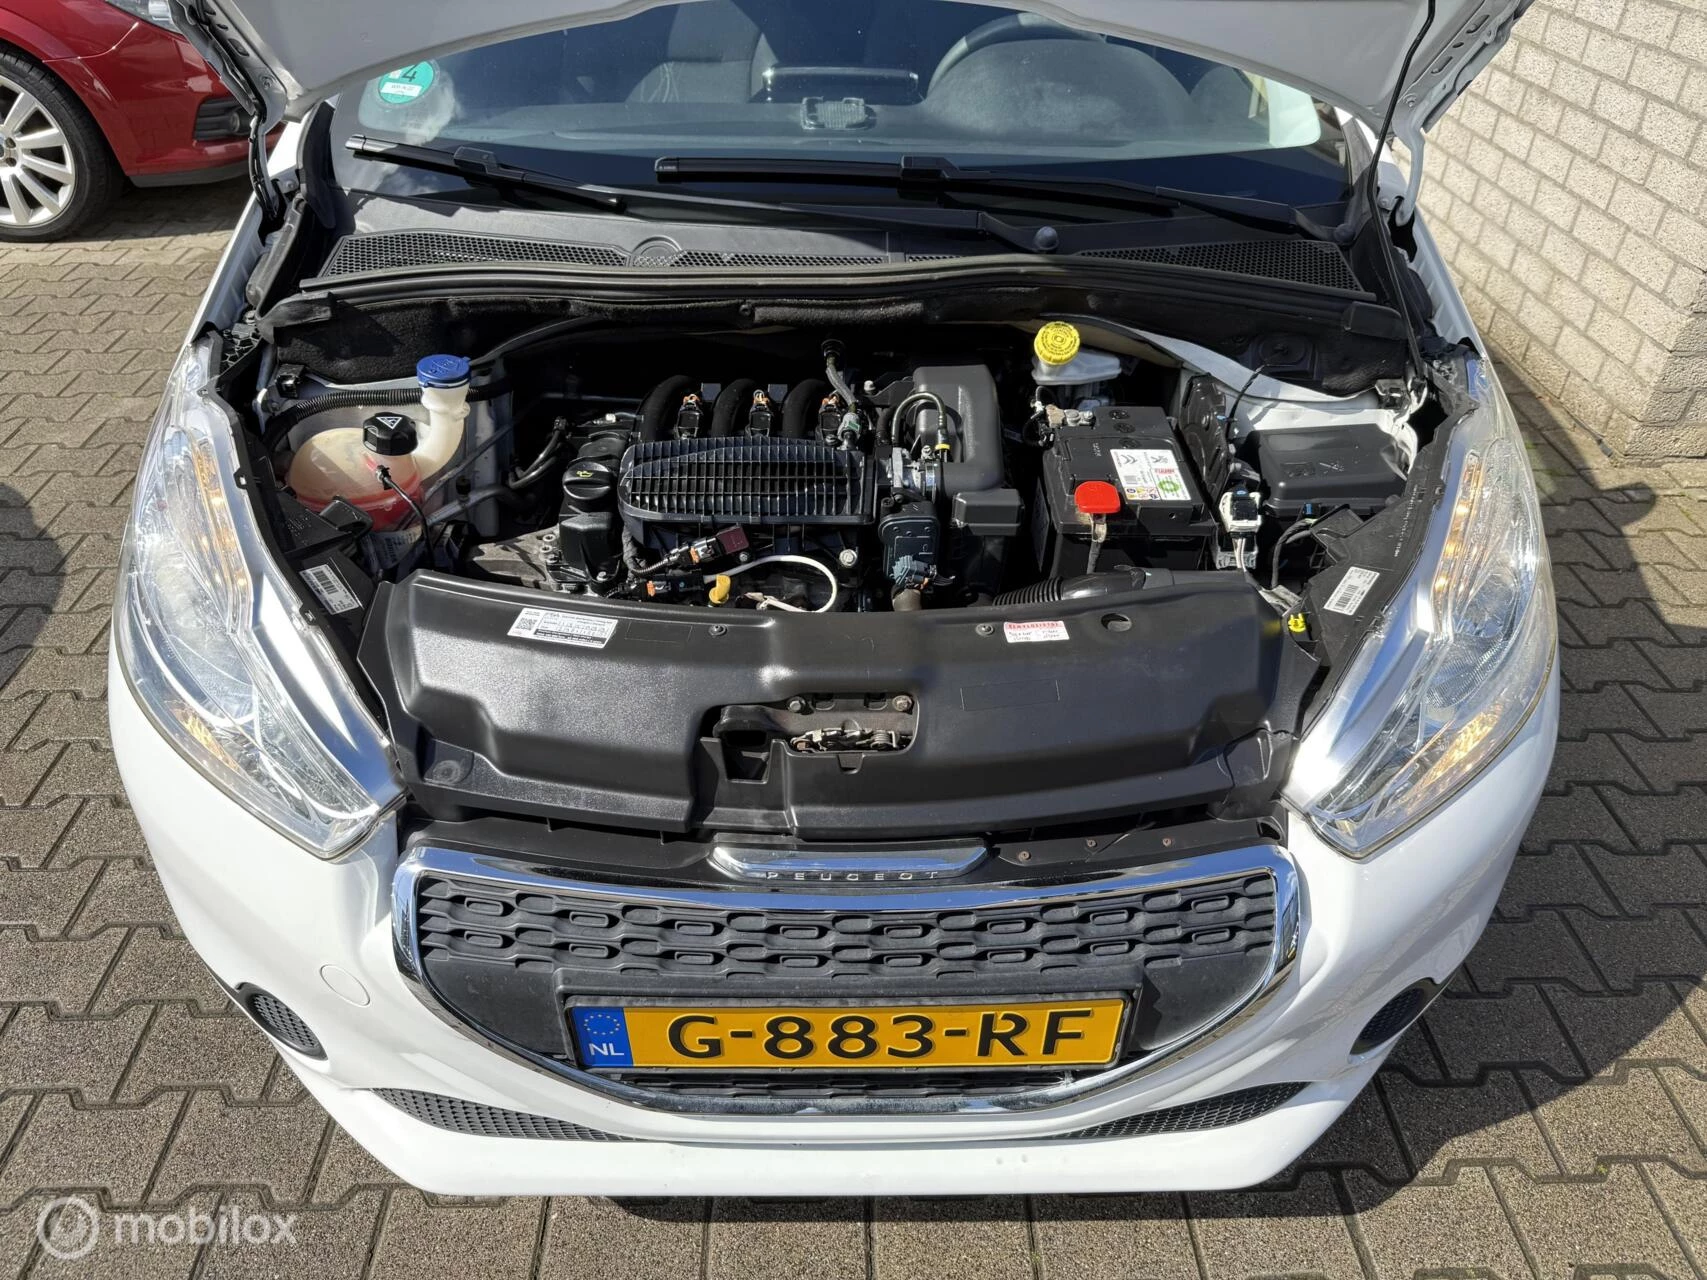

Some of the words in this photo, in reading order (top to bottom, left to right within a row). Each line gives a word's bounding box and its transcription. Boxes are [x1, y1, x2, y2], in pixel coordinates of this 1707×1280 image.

[766, 870, 938, 882] PEUGEOT
[667, 1008, 1093, 1060] G-883-RF
[588, 1042, 625, 1057] NL
